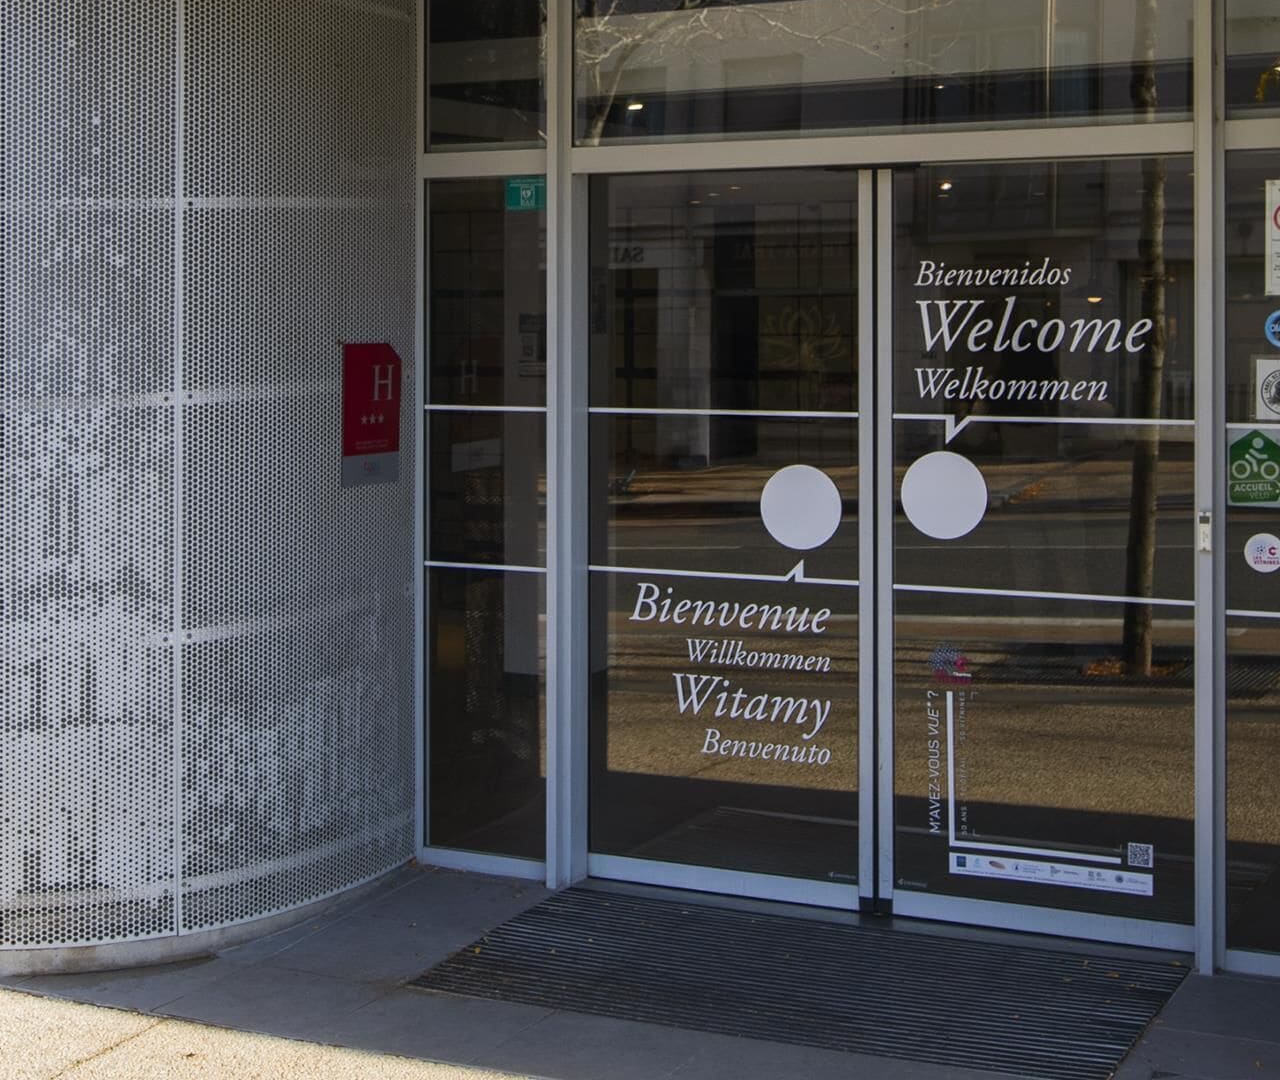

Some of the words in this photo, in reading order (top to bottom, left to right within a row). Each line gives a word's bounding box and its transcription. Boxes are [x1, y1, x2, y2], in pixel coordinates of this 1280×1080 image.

[913, 257, 1072, 287] Bienvenidos
[915, 295, 1153, 353] Welcome
[373, 364, 395, 401] H
[914, 366, 1109, 401] Welkommen
[1234, 483, 1273, 492] ACCUEIL
[629, 582, 831, 633] Bienvenue
[686, 638, 831, 672] Willkommen
[672, 672, 831, 740] Witamy
[701, 728, 831, 765] Benvenuto
